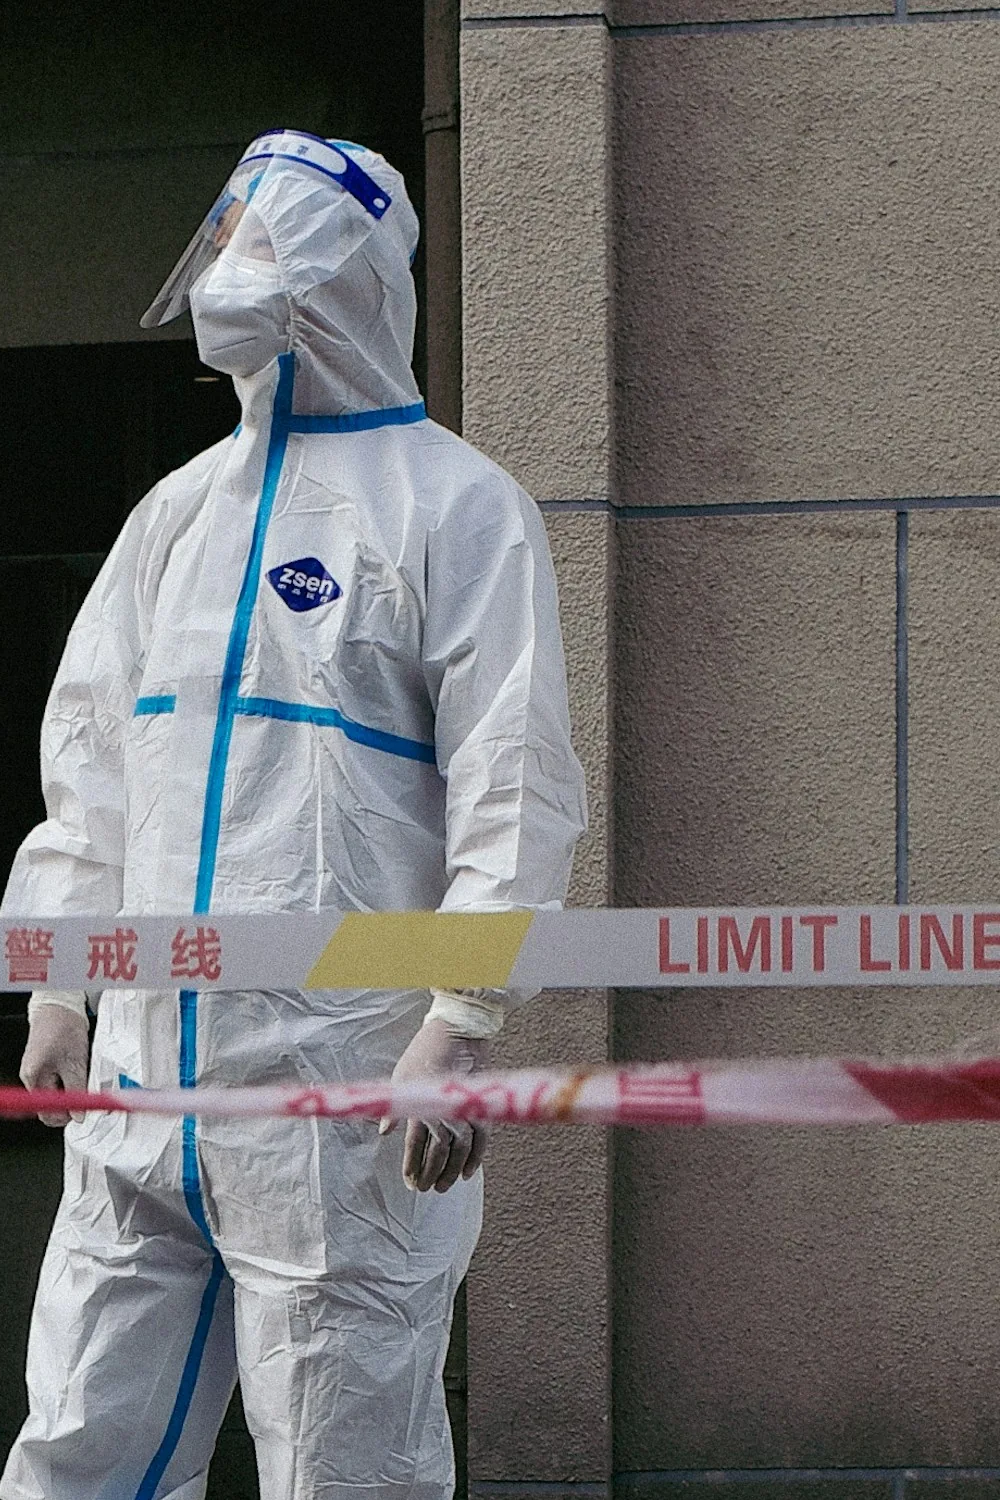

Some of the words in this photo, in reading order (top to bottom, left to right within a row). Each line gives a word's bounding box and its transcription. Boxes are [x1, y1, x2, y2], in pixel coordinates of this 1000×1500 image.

[5, 927, 222, 982] 警戒线
[658, 915, 838, 973] LIMIT
[859, 913, 1000, 971] LINE
